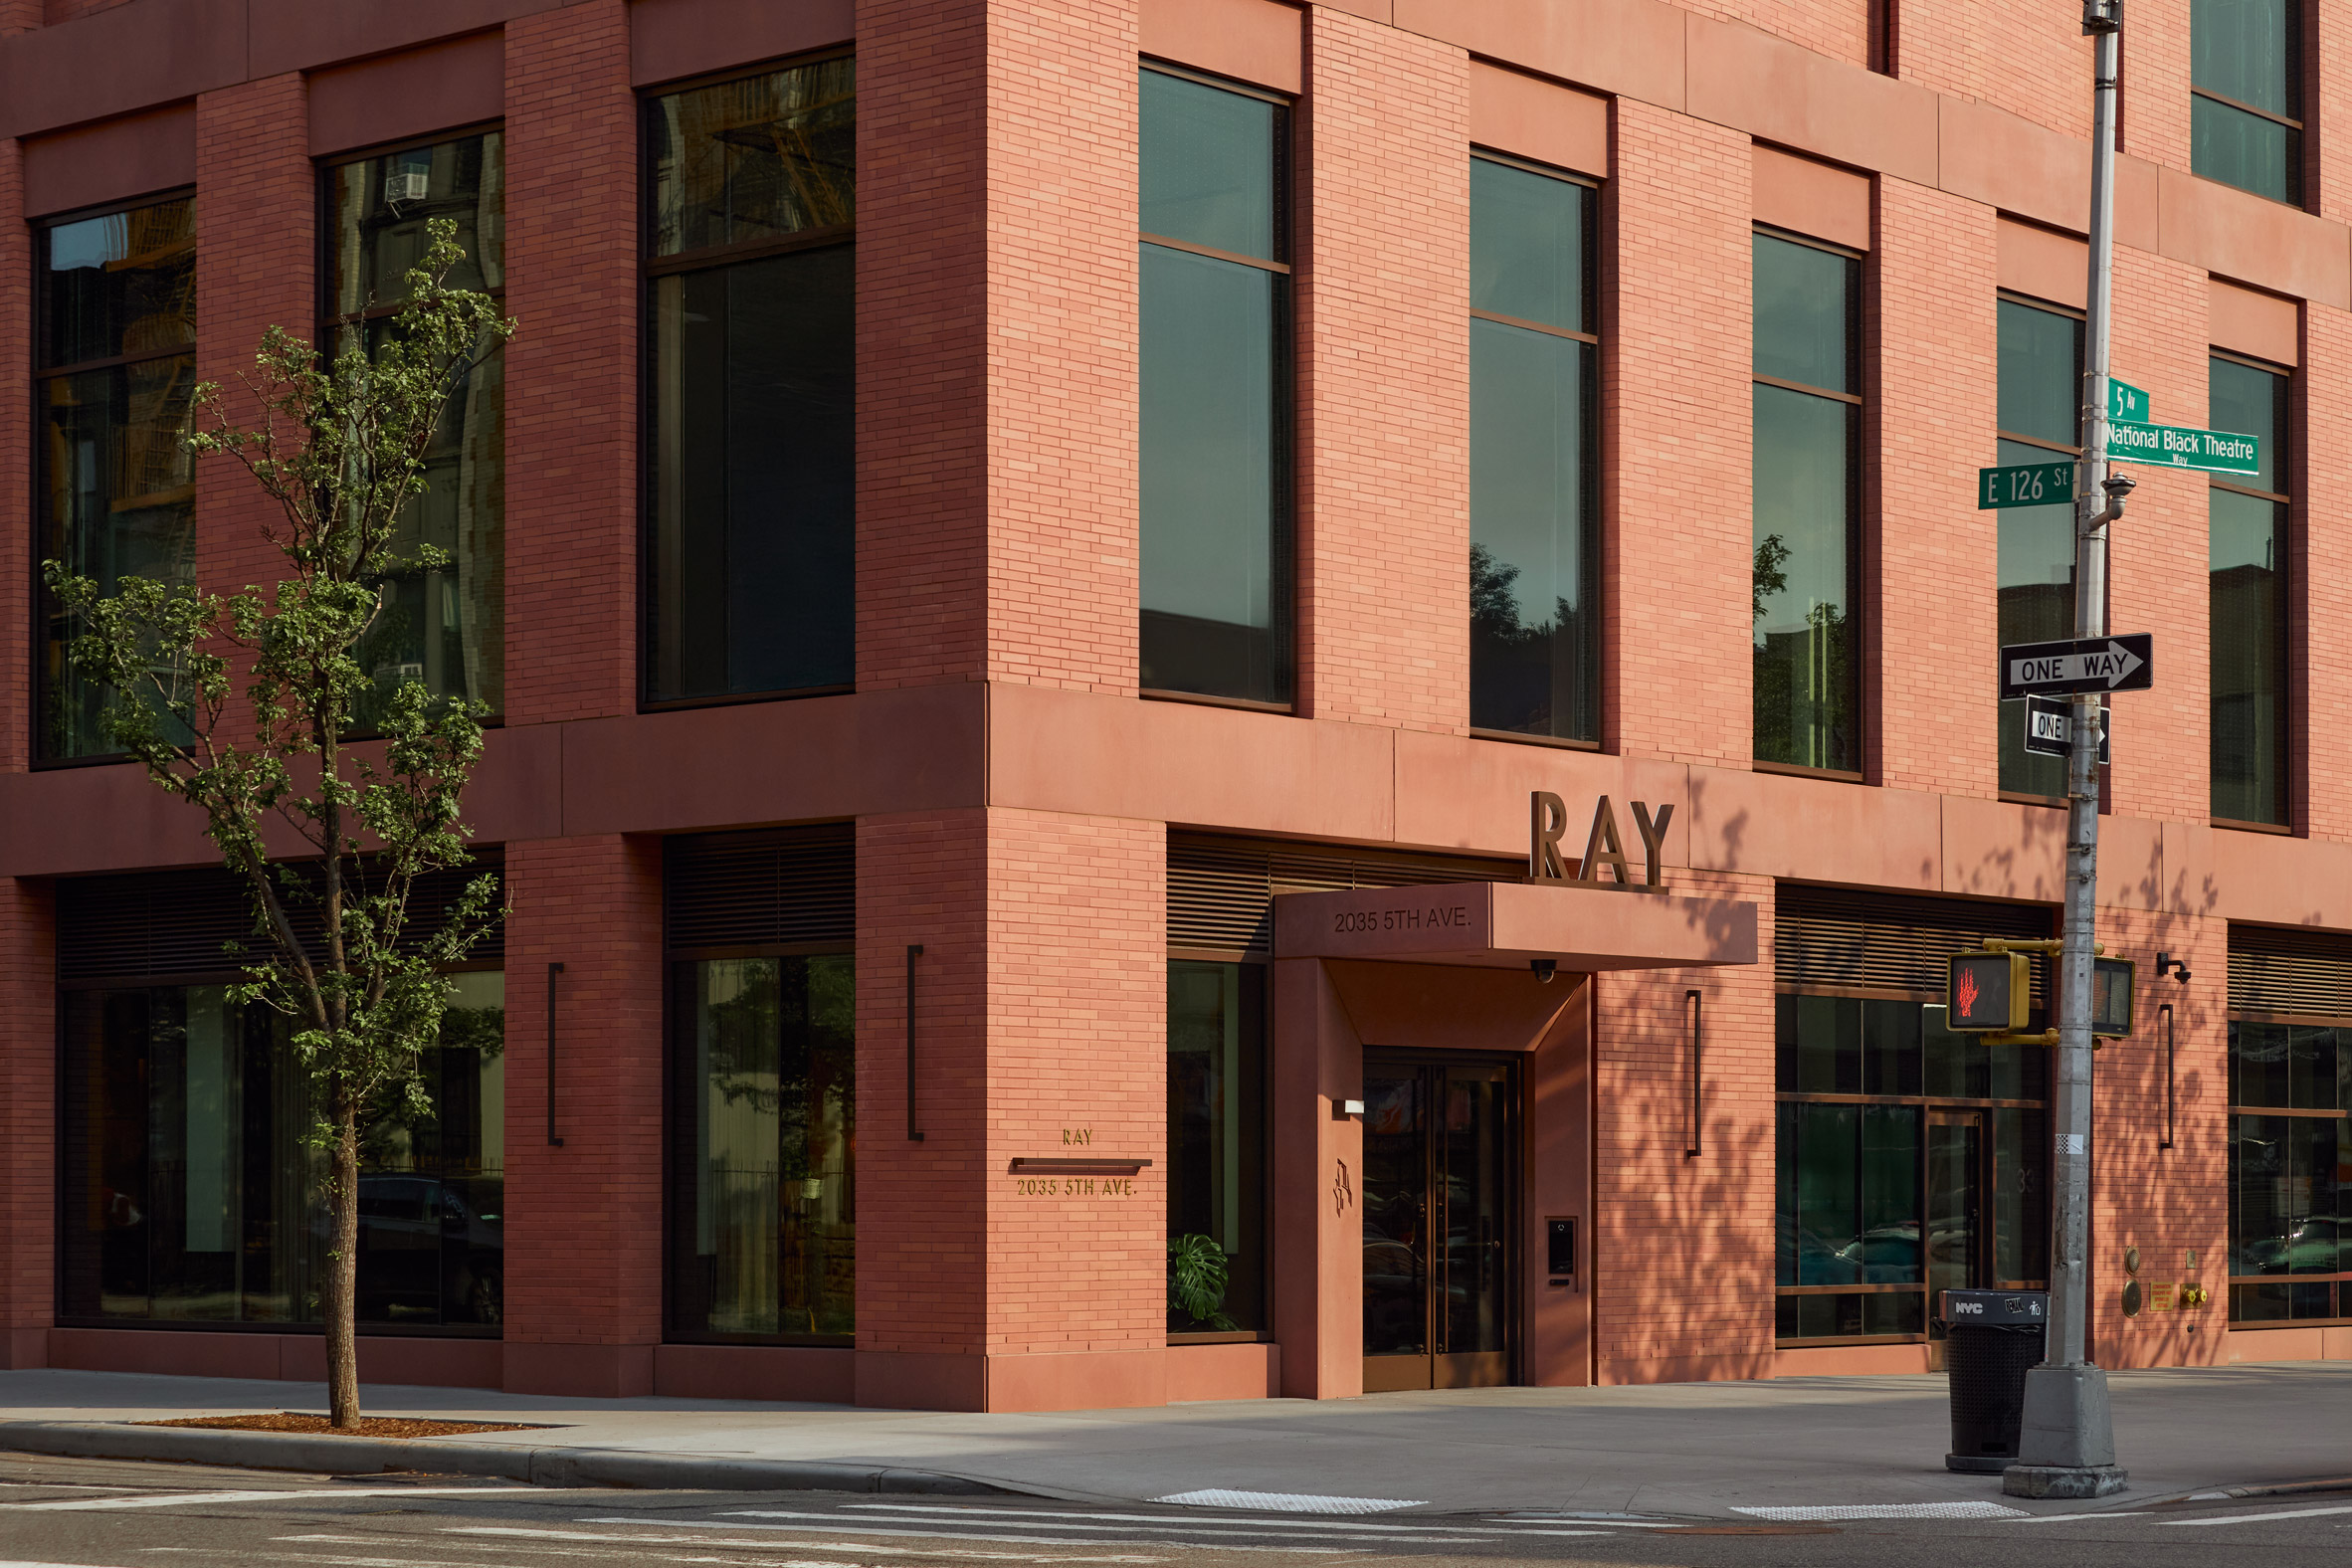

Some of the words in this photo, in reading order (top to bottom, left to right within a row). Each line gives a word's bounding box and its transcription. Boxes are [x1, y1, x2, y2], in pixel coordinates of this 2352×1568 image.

[2116, 386, 2123, 417] 5
[2107, 423, 2158, 449] National
[2163, 430, 2199, 454] Black
[2204, 435, 2254, 460] Theatre
[2172, 454, 2188, 468] Way
[1988, 474, 1999, 503] E
[2010, 470, 2043, 500] 126
[2054, 468, 2067, 487] St
[2022, 659, 2063, 682] ONE
[2083, 653, 2128, 677] WAY
[2038, 714, 2061, 738] ONE
[1529, 791, 1674, 885] RAY
[1334, 910, 1378, 933] 2035
[1383, 908, 1420, 930] 5TH
[1426, 905, 1471, 928] AVE.
[1063, 1128, 1093, 1145] RAY
[1017, 1179, 1057, 1196] 2035
[1065, 1179, 1094, 1195] 5TH
[1101, 1179, 1137, 1196] AVE.
[1955, 1302, 1984, 1314] NYC
